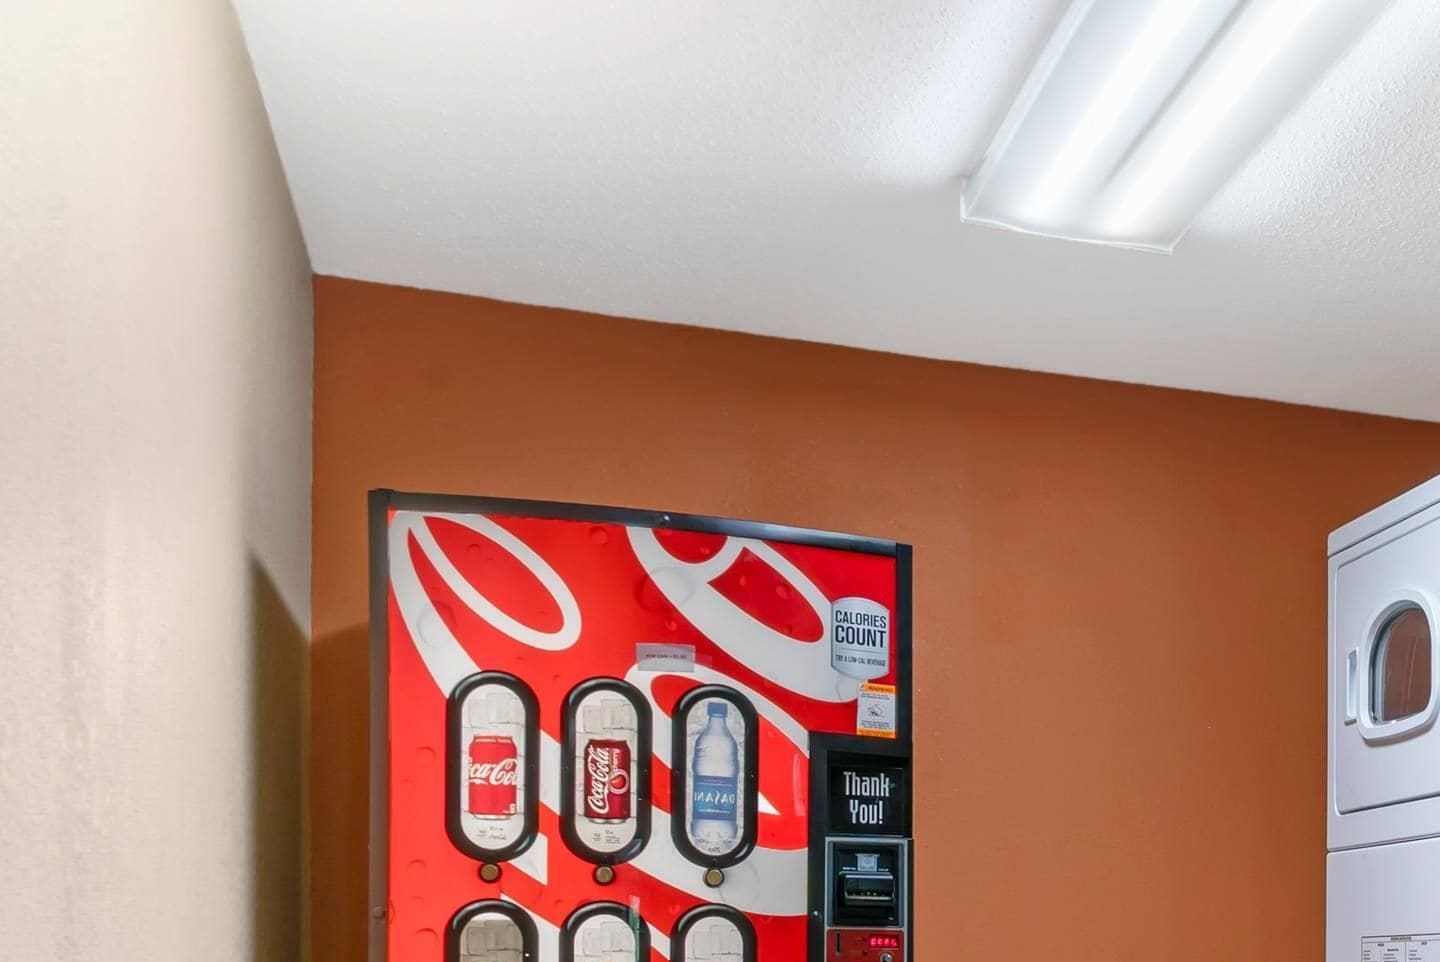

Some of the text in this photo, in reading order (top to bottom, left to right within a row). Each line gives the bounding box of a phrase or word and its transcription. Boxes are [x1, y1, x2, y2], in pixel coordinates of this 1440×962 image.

[835, 609, 887, 629] CALORIES
[835, 624, 887, 648] COUNT
[587, 745, 612, 814] Coca-Cola
[843, 771, 890, 797] Thank
[850, 799, 884, 825] You!
